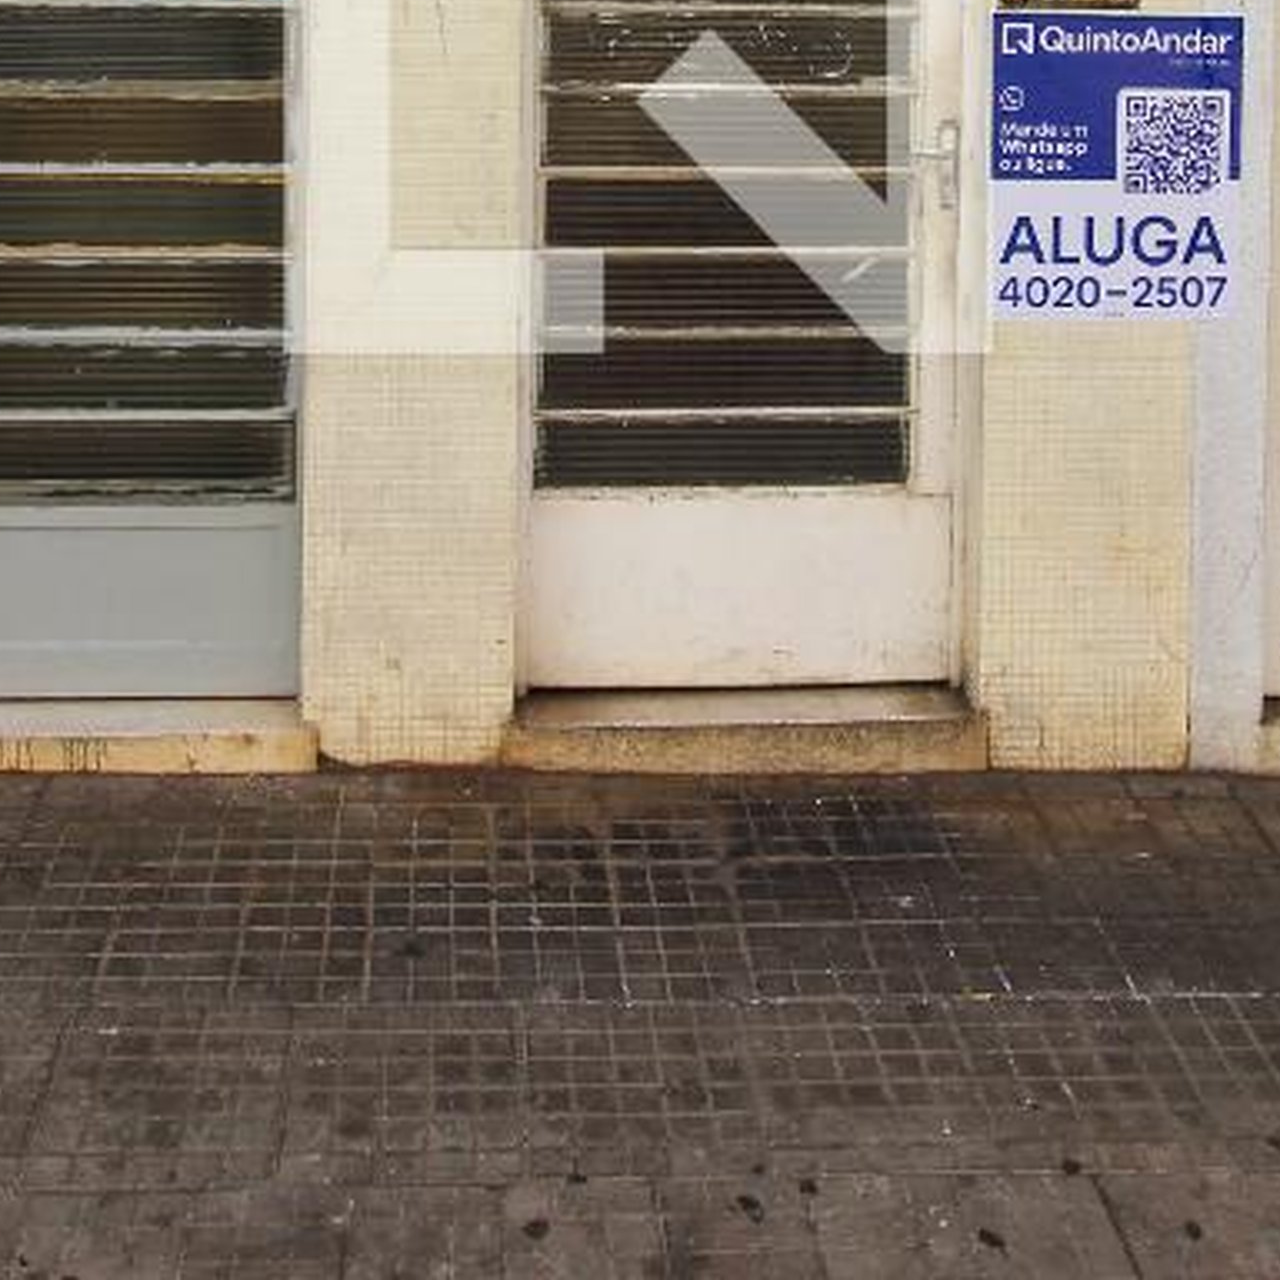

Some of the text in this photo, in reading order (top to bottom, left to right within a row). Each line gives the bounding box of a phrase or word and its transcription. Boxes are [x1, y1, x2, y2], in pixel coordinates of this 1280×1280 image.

[1039, 26, 1233, 55] QuintoAndar
[999, 215, 1227, 266] ALUGA
[999, 276, 1228, 308] 4020-2507
